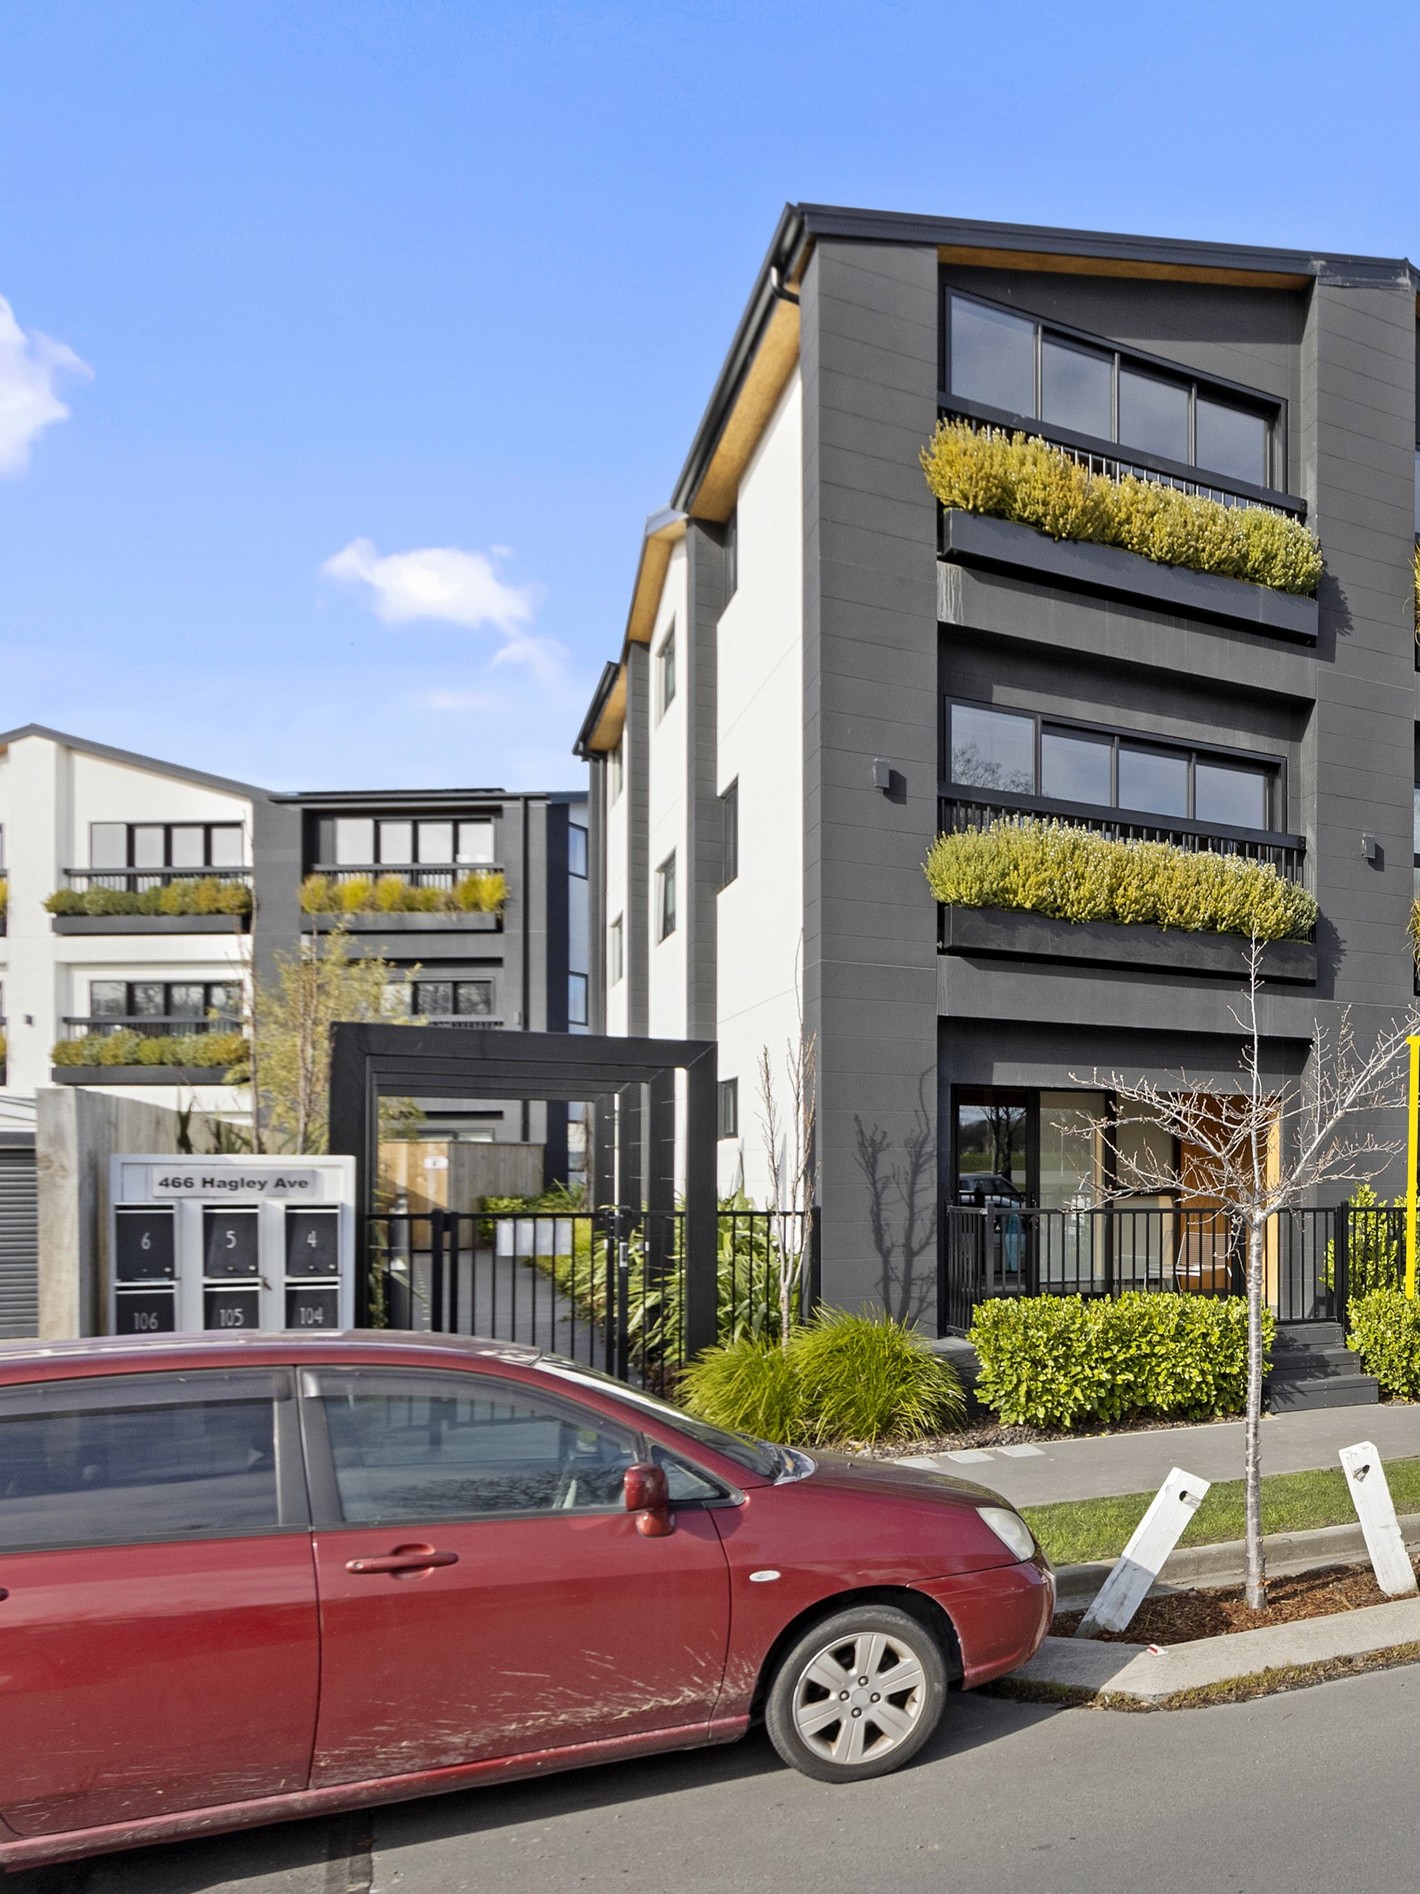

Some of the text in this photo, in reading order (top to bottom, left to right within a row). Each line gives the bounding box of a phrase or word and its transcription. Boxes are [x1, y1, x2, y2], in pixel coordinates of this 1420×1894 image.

[158, 1176, 309, 1191] 466 Hagley Ave
[140, 1232, 151, 1250] 6
[225, 1230, 237, 1249] 5
[306, 1230, 318, 1248] 4
[133, 1312, 159, 1330] 106
[219, 1308, 245, 1327] 105
[300, 1307, 325, 1325] 104
